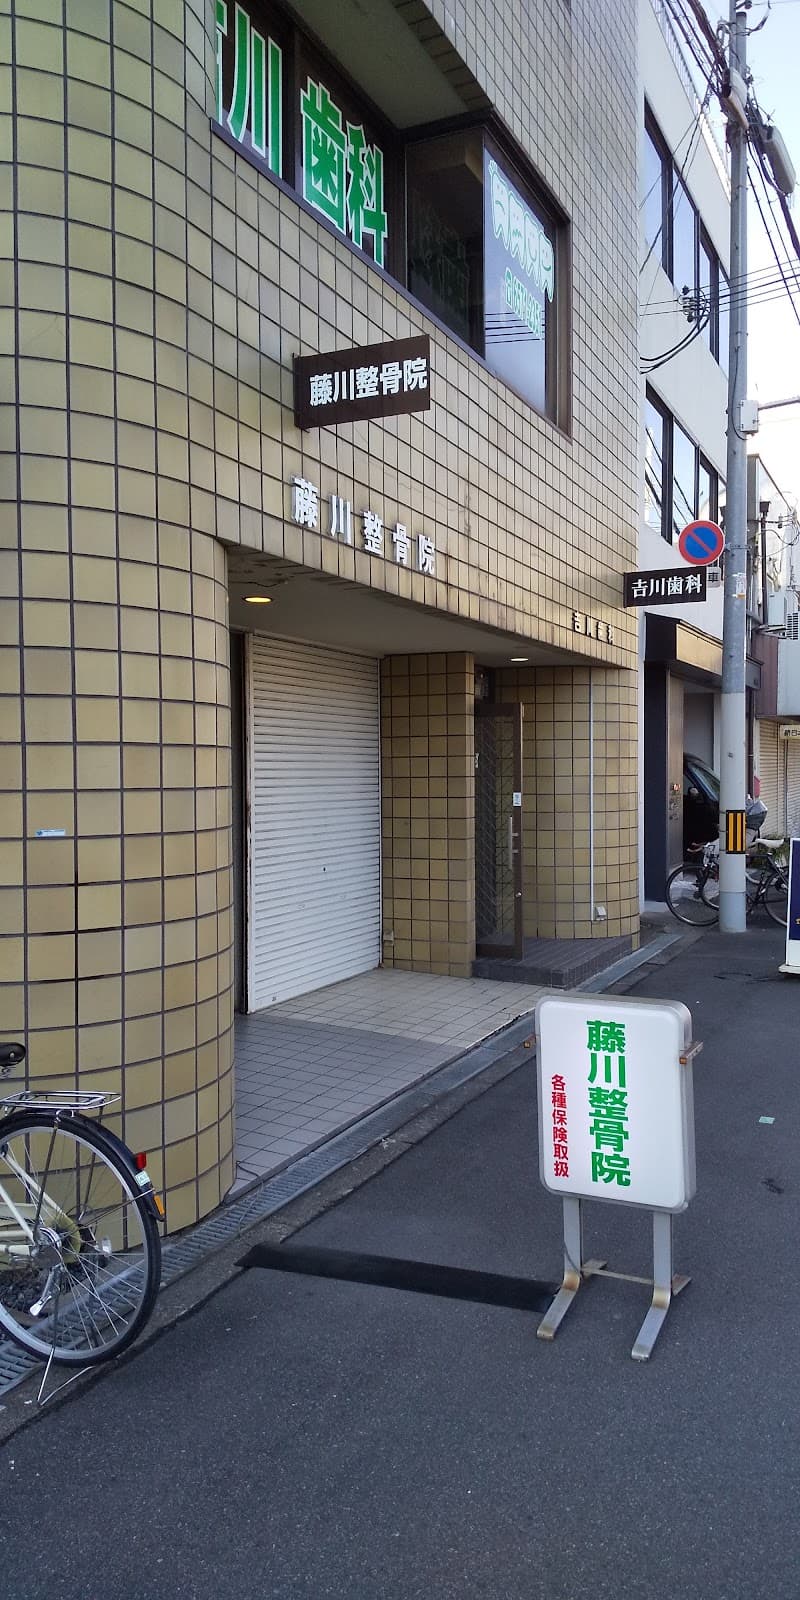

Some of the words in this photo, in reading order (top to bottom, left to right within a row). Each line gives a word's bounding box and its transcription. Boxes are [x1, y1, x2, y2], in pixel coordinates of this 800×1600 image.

[216, 0, 388, 270] 川歯科
[309, 357, 428, 407] 藤川整骨院
[291, 474, 436, 576] 藤川整骨院
[631, 573, 703, 598] 吉川歯科
[551, 1073, 569, 1178] 各種保険取扱
[586, 1019, 631, 1187] 藤川整骨院
